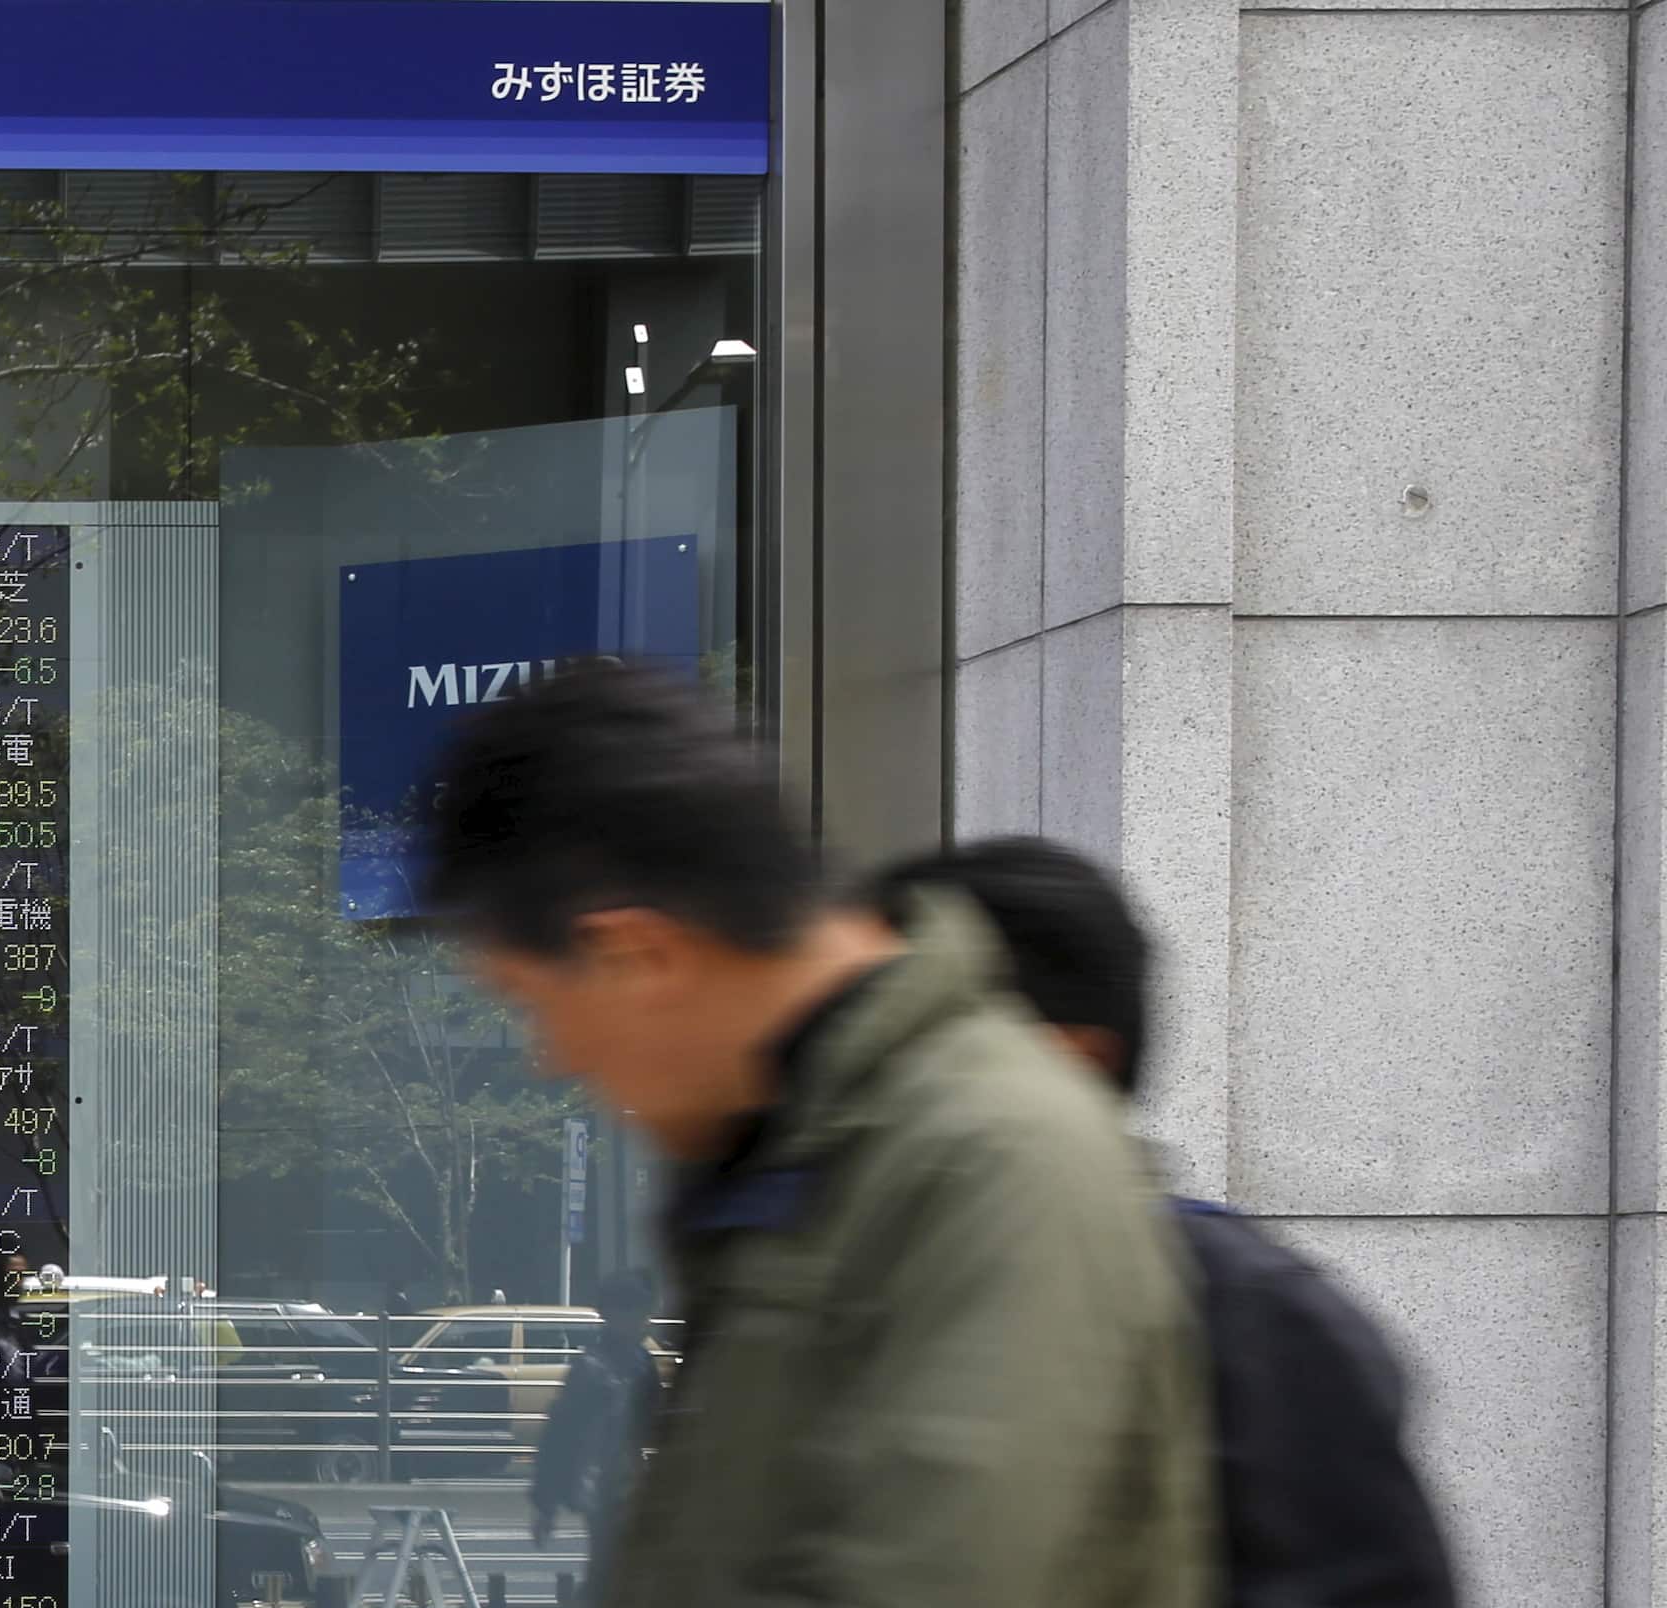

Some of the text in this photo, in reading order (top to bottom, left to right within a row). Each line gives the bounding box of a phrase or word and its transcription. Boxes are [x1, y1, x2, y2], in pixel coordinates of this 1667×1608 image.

[491, 60, 707, 104] みずほ証券
